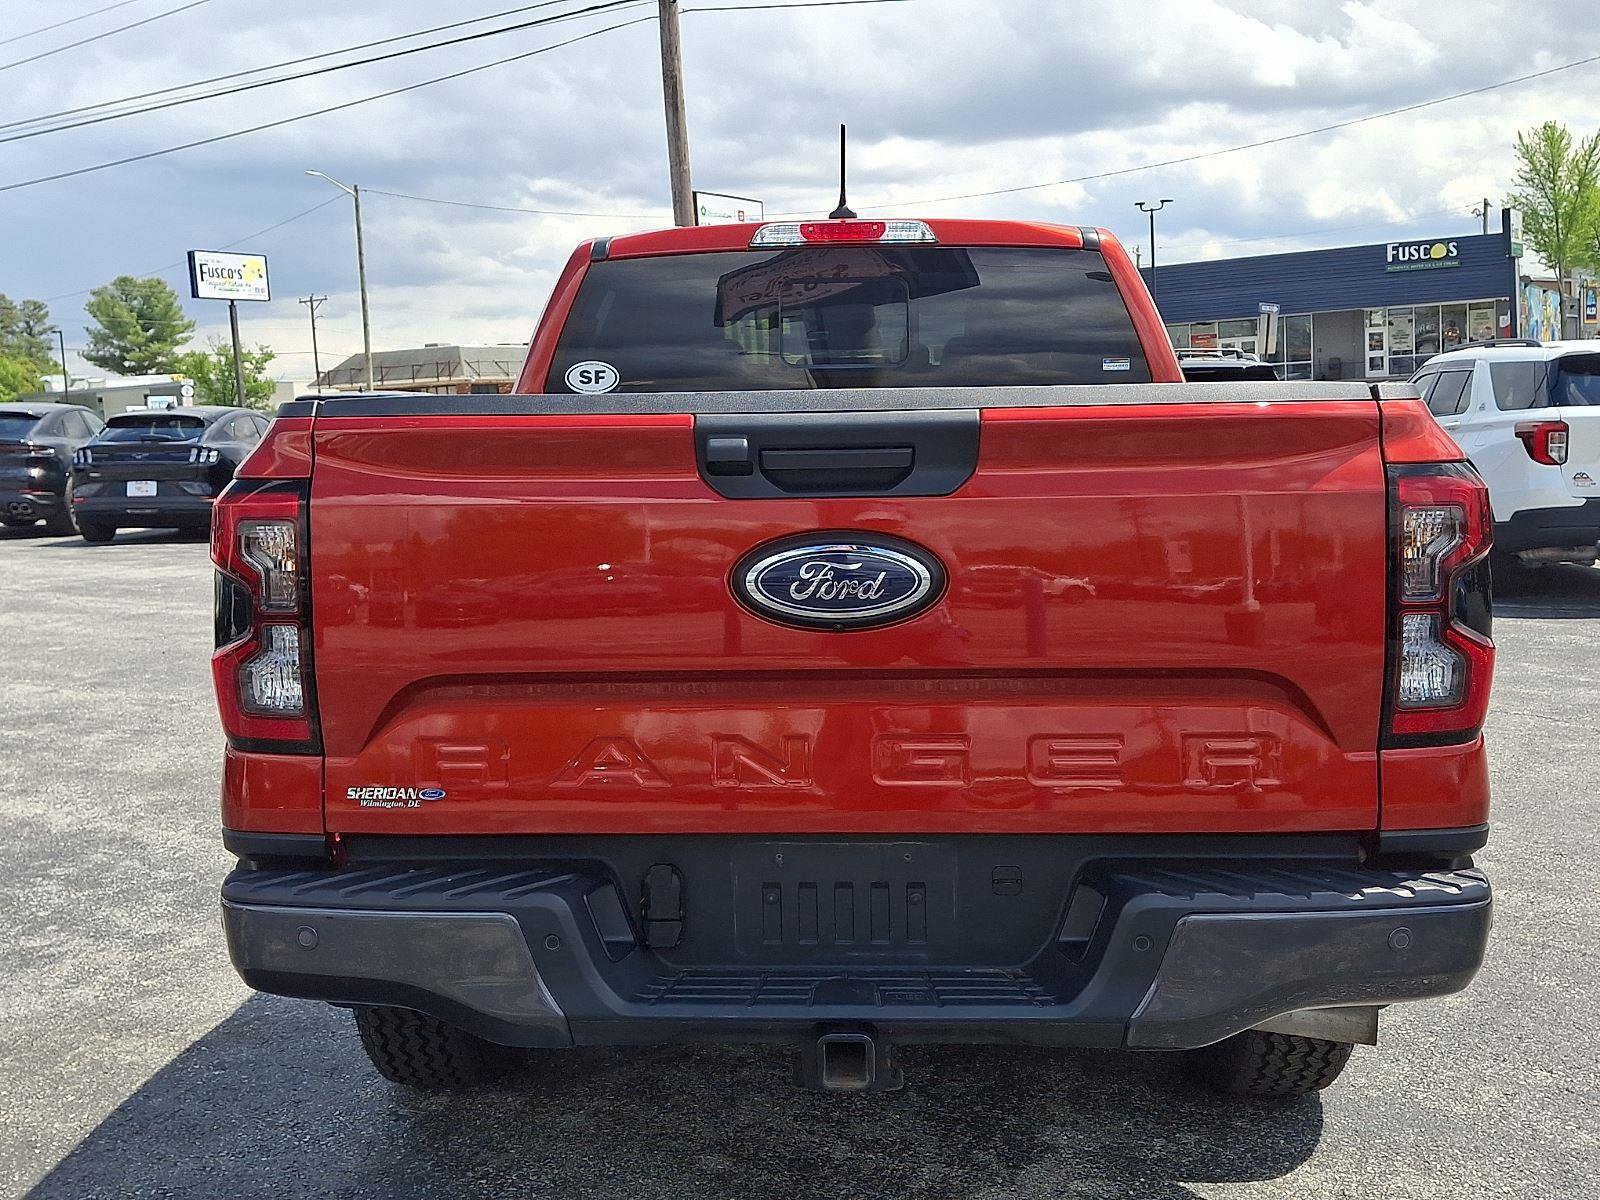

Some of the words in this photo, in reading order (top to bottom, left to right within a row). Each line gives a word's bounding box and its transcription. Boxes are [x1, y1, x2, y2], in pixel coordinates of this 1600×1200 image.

[579, 370, 606, 384] SF
[789, 561, 887, 601] Ford
[416, 732, 1281, 789] RANGER
[347, 787, 418, 800] SHERIDAN
[360, 800, 406, 808] Wilmington,
